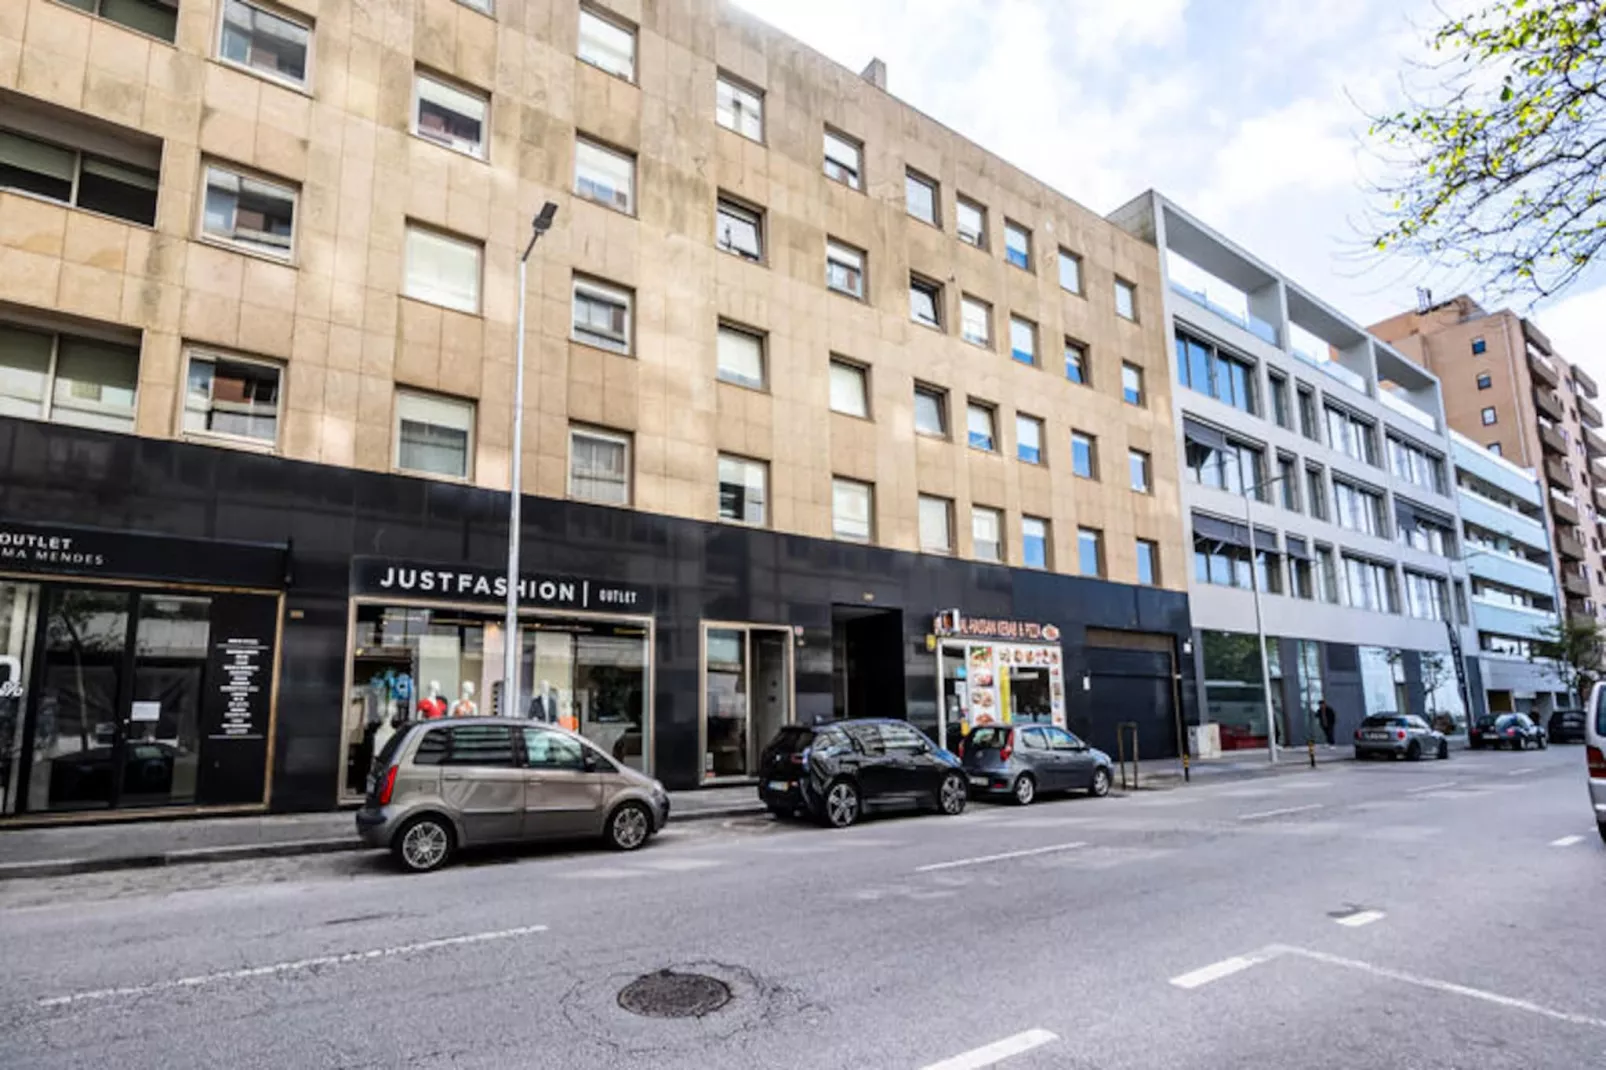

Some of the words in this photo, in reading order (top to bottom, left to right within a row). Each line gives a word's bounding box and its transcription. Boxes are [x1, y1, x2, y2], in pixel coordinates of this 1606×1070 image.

[0, 532, 72, 550] OUTLET
[36, 550, 103, 566] MENDES
[599, 588, 637, 604] OUTLET
